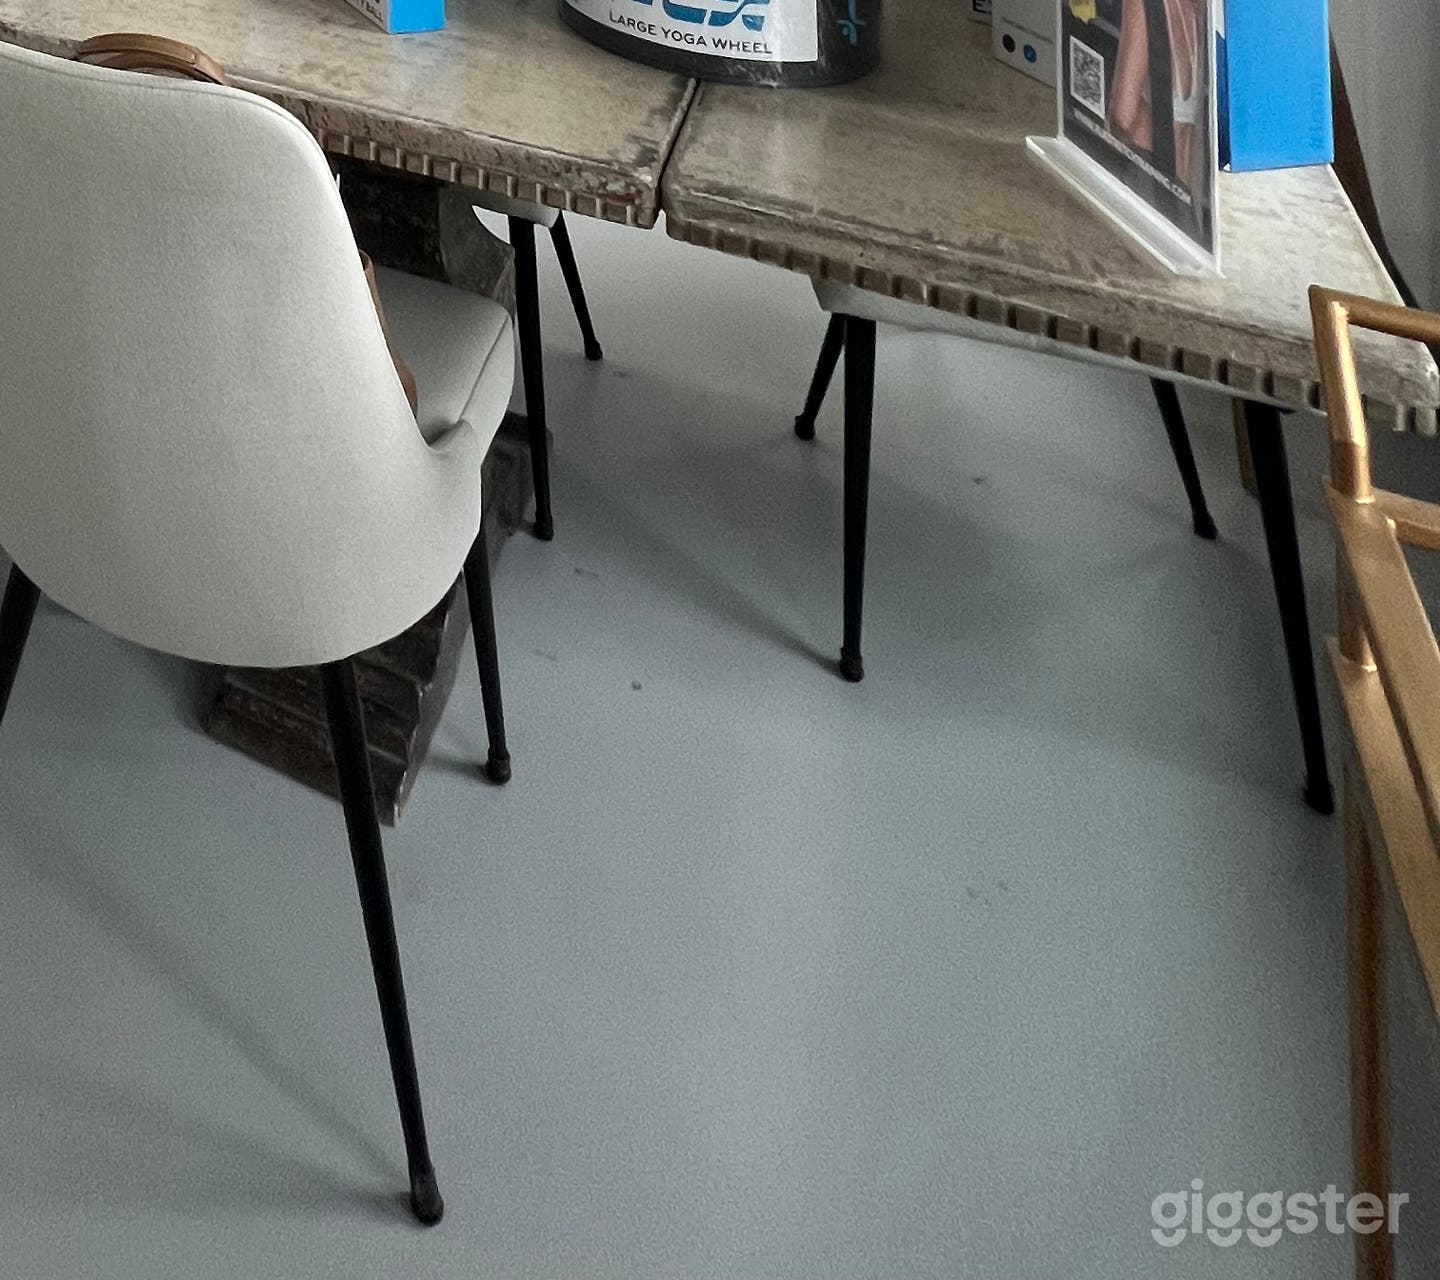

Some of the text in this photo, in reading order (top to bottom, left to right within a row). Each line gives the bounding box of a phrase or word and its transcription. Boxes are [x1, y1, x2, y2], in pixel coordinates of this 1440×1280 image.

[610, 11, 773, 54] LARGE YOGA WHEEL
